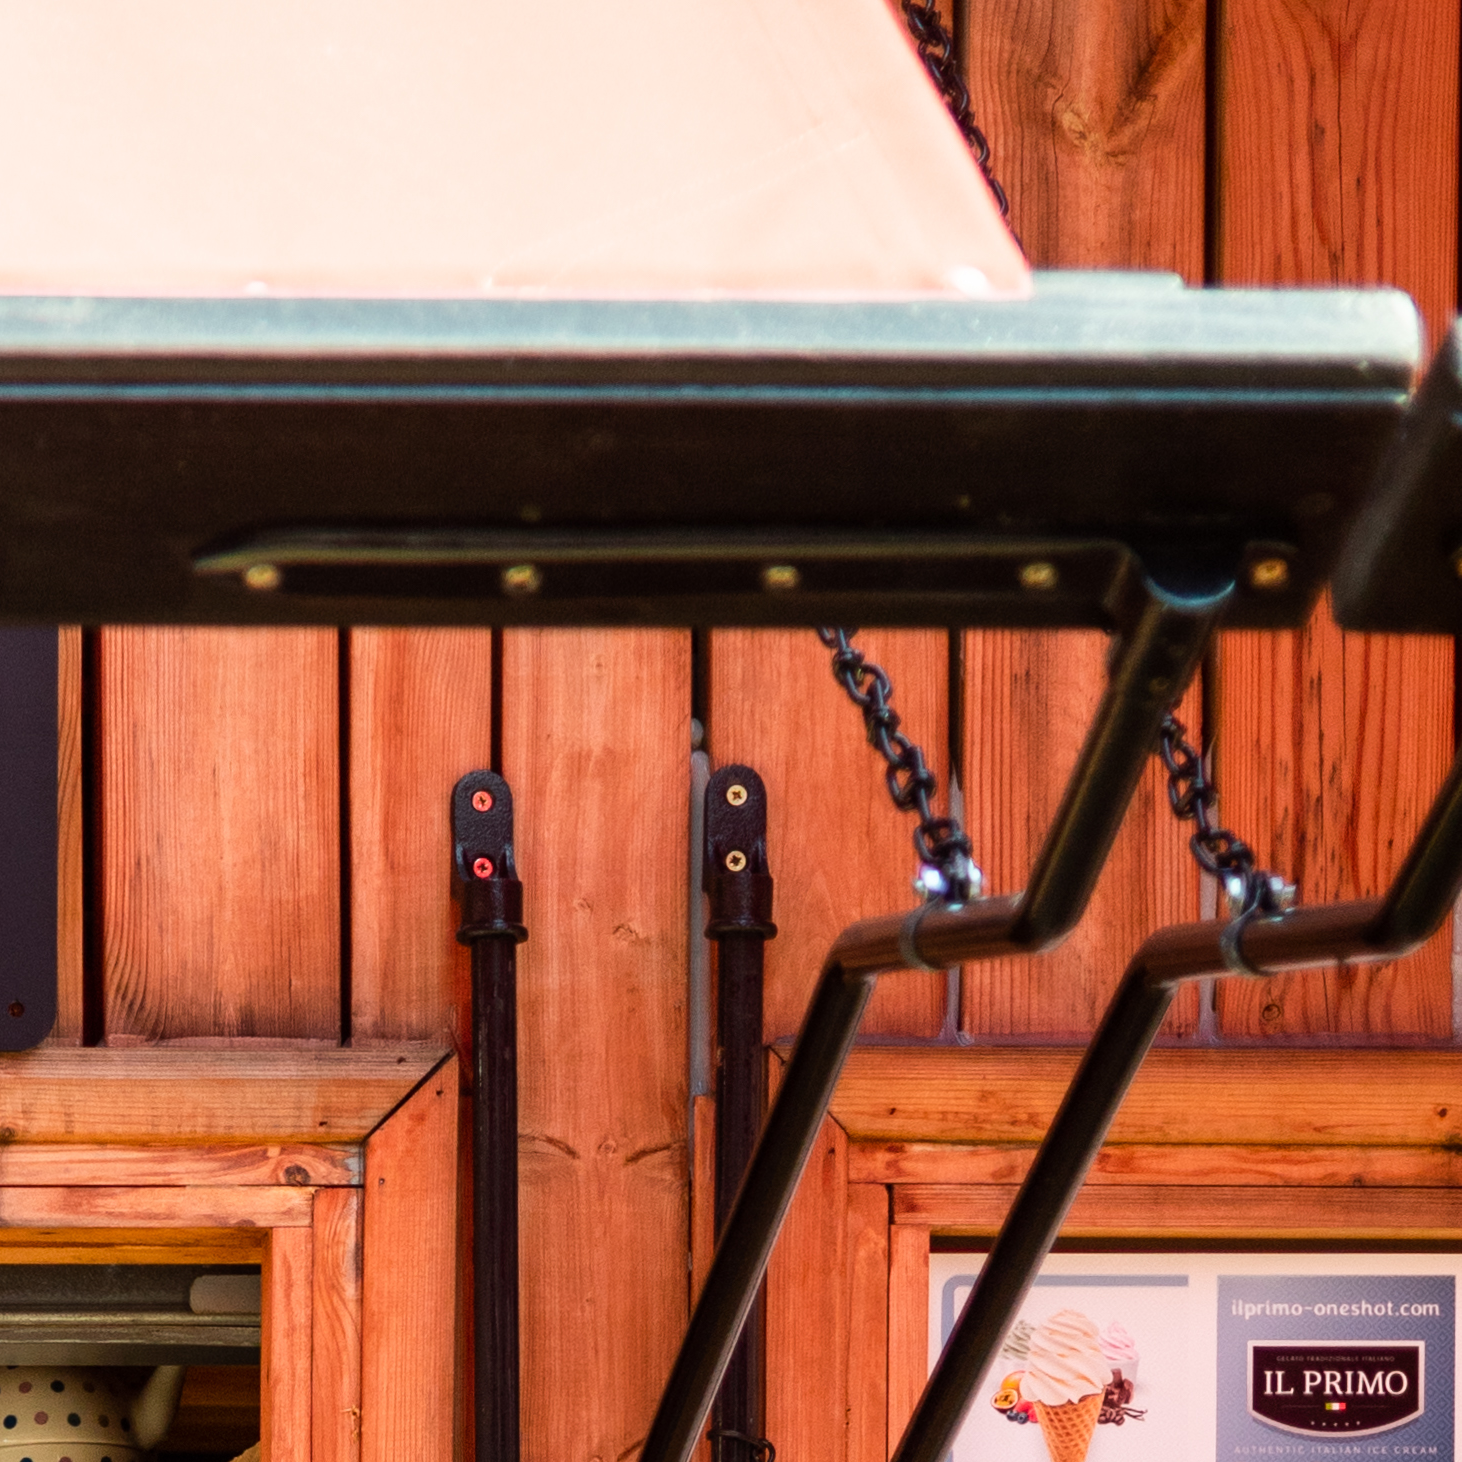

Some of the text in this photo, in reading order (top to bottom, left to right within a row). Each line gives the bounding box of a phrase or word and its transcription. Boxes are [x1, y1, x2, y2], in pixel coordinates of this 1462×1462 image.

[1231, 1299, 1441, 1320] ilprimo-oneshot.com
[1263, 1370, 1409, 1396] IL PRIMO
[1234, 1445, 1439, 1455] AUTHENTIC ITALIAN ICE CREAM
